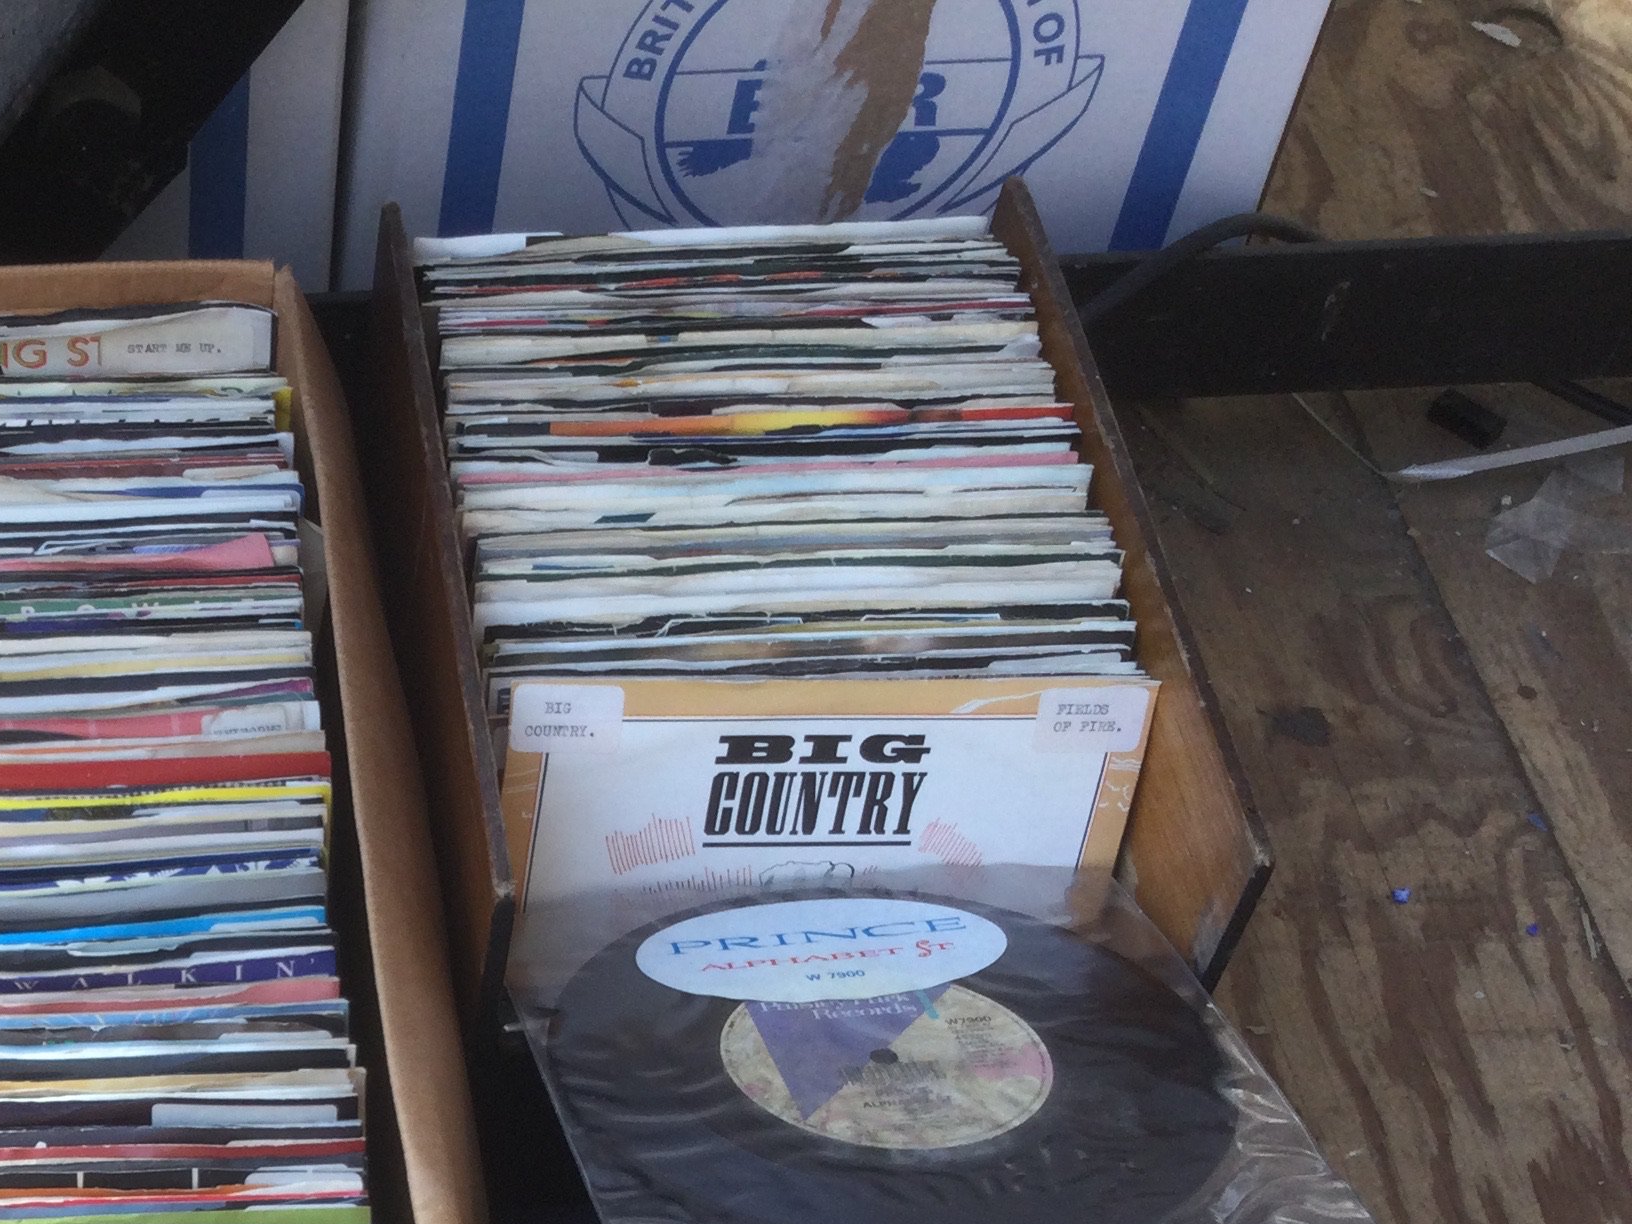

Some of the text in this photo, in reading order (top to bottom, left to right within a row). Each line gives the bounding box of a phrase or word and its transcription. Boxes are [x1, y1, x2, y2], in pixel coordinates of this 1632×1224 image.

[1032, 11, 1066, 67] OF
[126, 342, 168, 355] START
[544, 701, 573, 715] BIG
[1055, 703, 1110, 716] FIELDS
[524, 725, 596, 738] COUNTRY.
[1052, 721, 1122, 733] OF FIRE.
[714, 734, 932, 765] BIG
[703, 771, 928, 836] COUNTRY
[668, 916, 967, 956] PRINCE
[701, 947, 905, 973] ALPHABET
[826, 968, 866, 981] 7900
